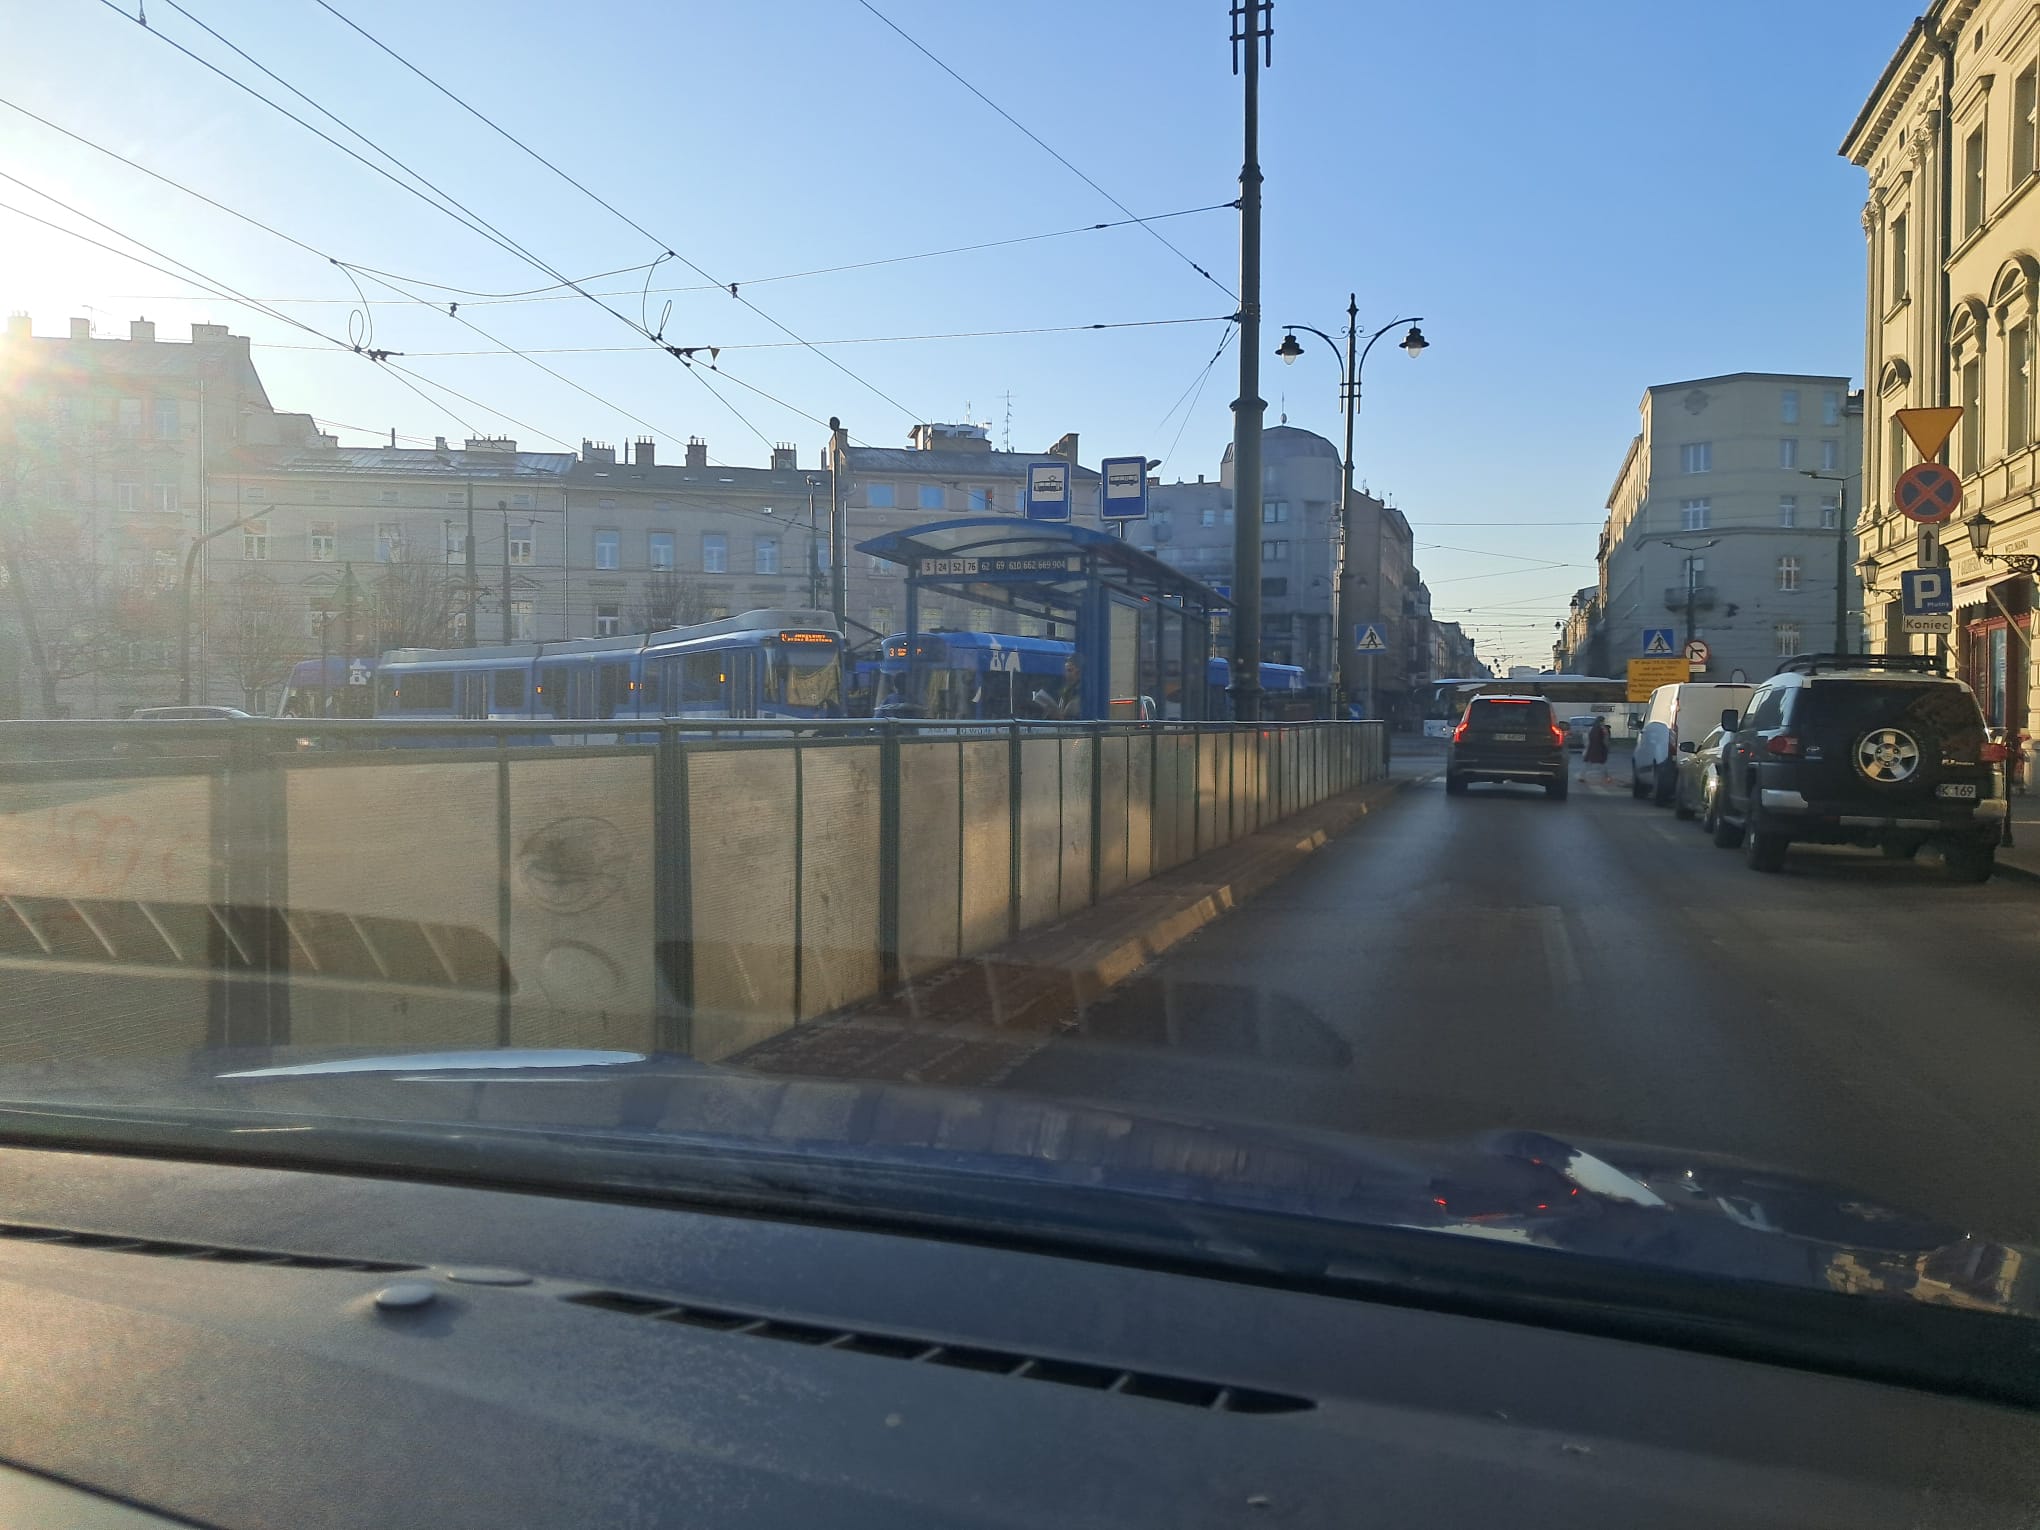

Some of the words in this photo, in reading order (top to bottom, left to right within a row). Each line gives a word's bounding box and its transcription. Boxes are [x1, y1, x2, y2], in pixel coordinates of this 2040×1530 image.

[925, 563, 931, 572] 3
[938, 562, 947, 572] 24
[952, 562, 961, 572] 52
[967, 561, 976, 571] 76
[996, 560, 1005, 570] 69
[1009, 560, 1021, 570] 610
[1023, 559, 1036, 569] 662
[1051, 559, 1065, 569] 904
[1913, 574, 1941, 608] P
[1906, 619, 1949, 630] Koniec
[889, 648, 895, 657] 3
